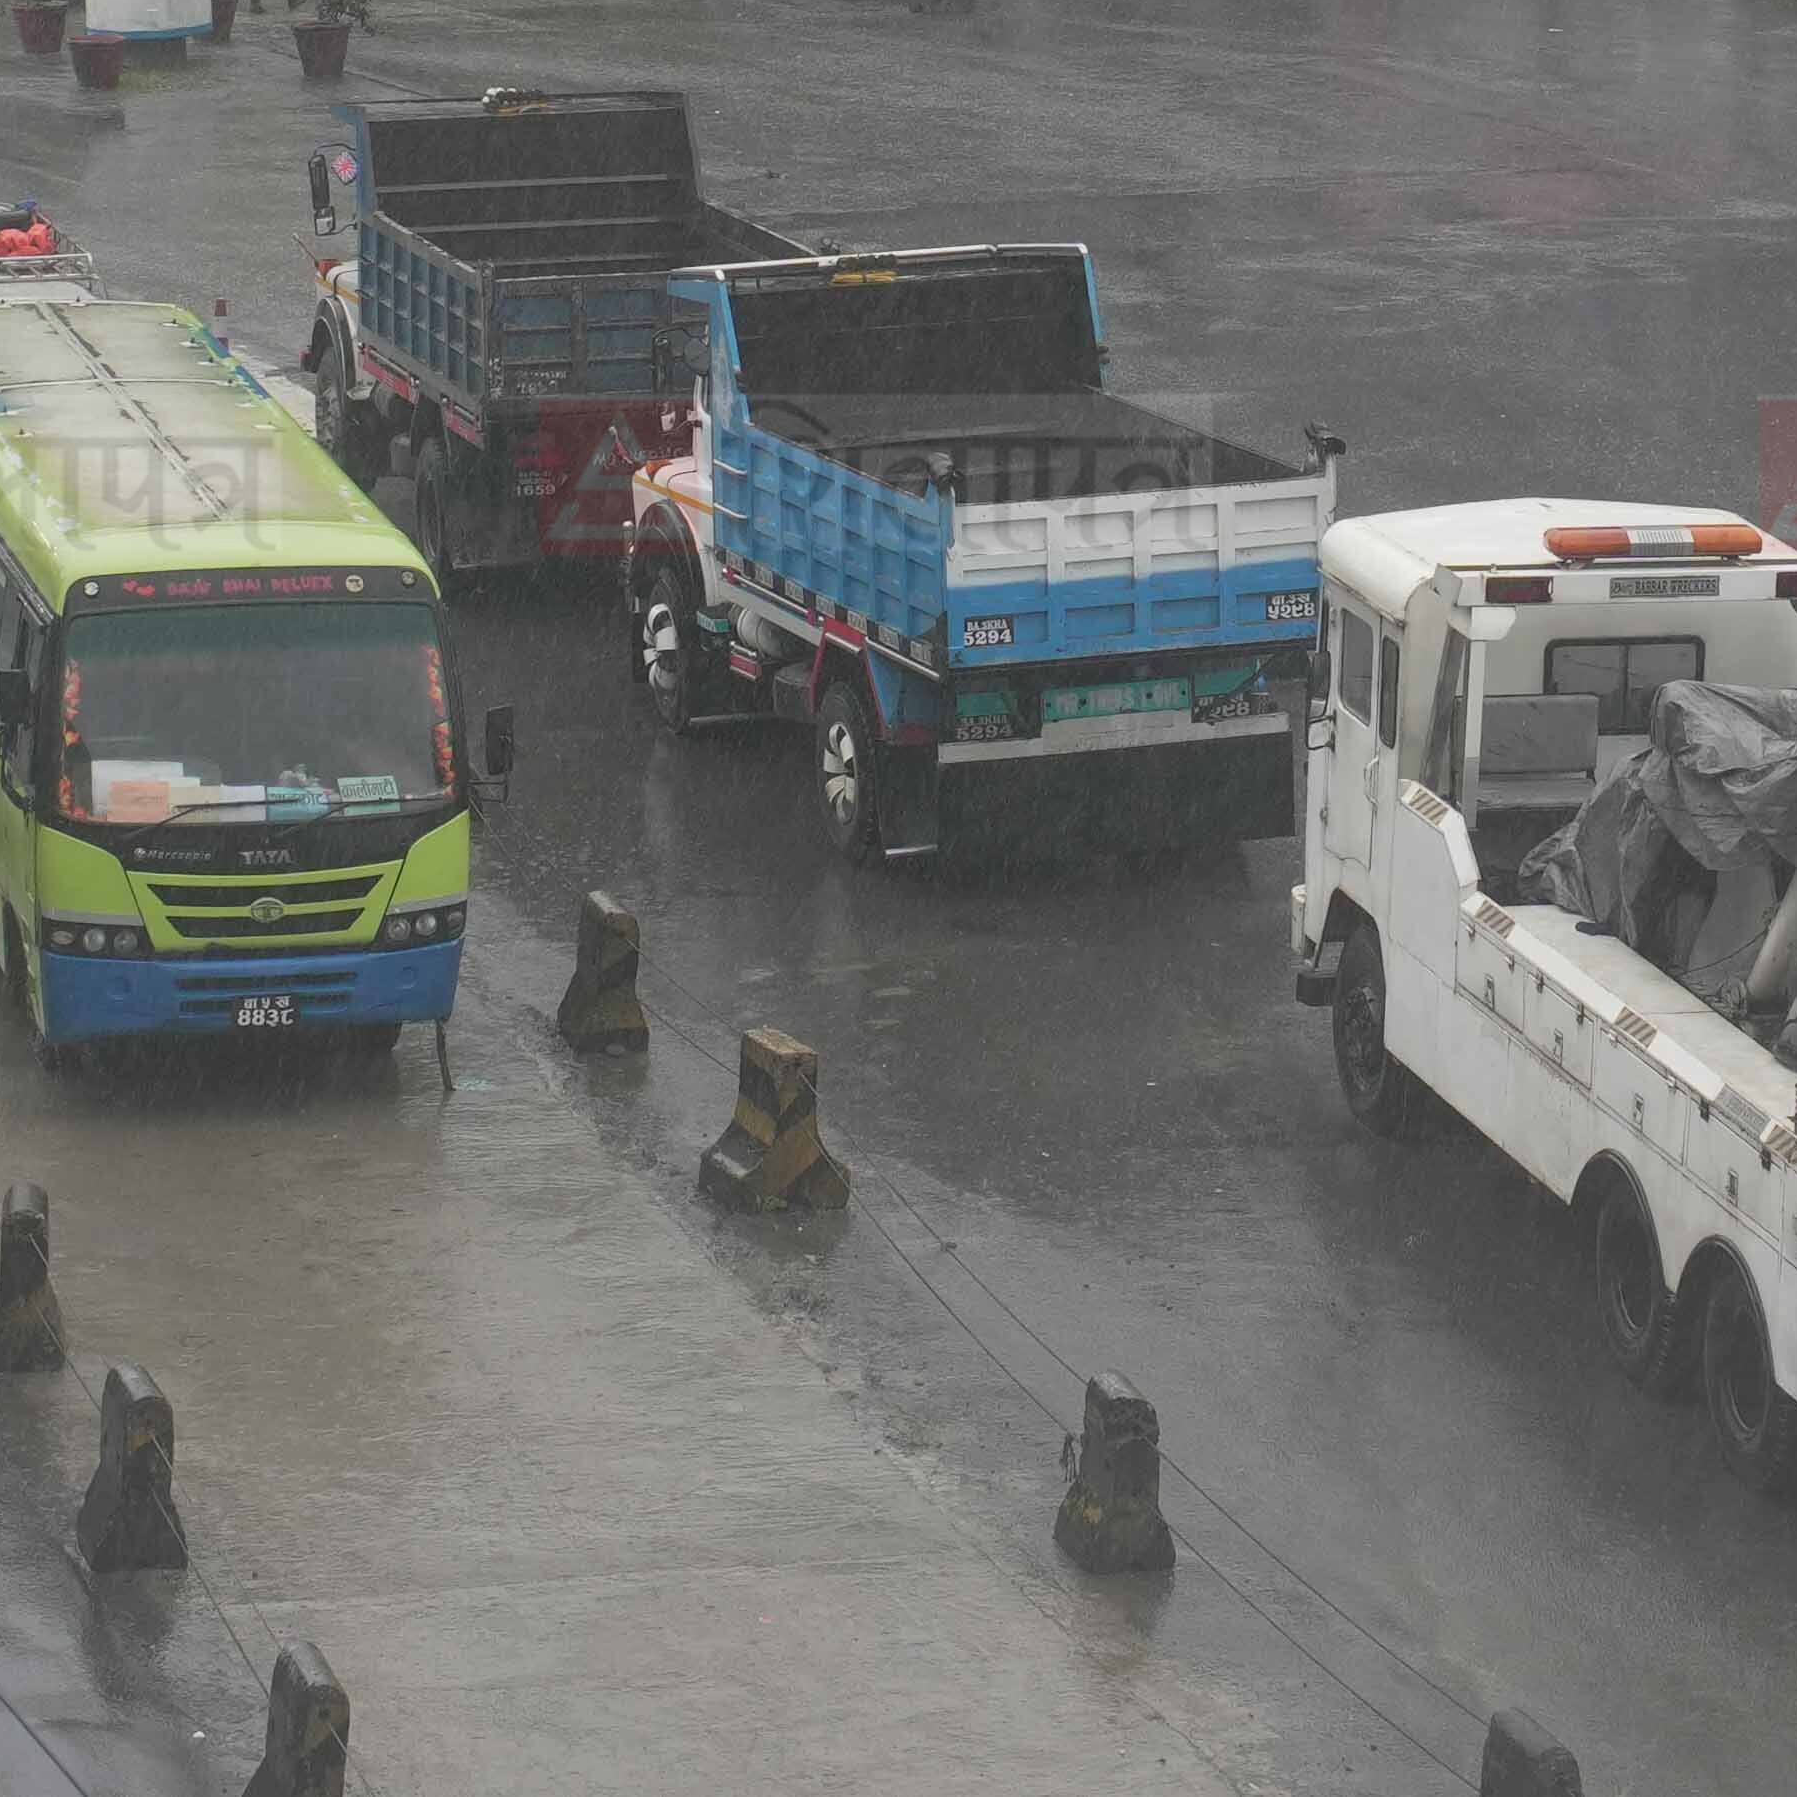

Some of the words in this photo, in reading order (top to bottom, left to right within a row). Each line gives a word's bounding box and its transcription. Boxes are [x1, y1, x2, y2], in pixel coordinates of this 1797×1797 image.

[964, 629, 1012, 646] 5294
[955, 723, 1013, 741] 5294
[342, 778, 396, 798] कालीमाटी
[239, 850, 293, 865] TATA
